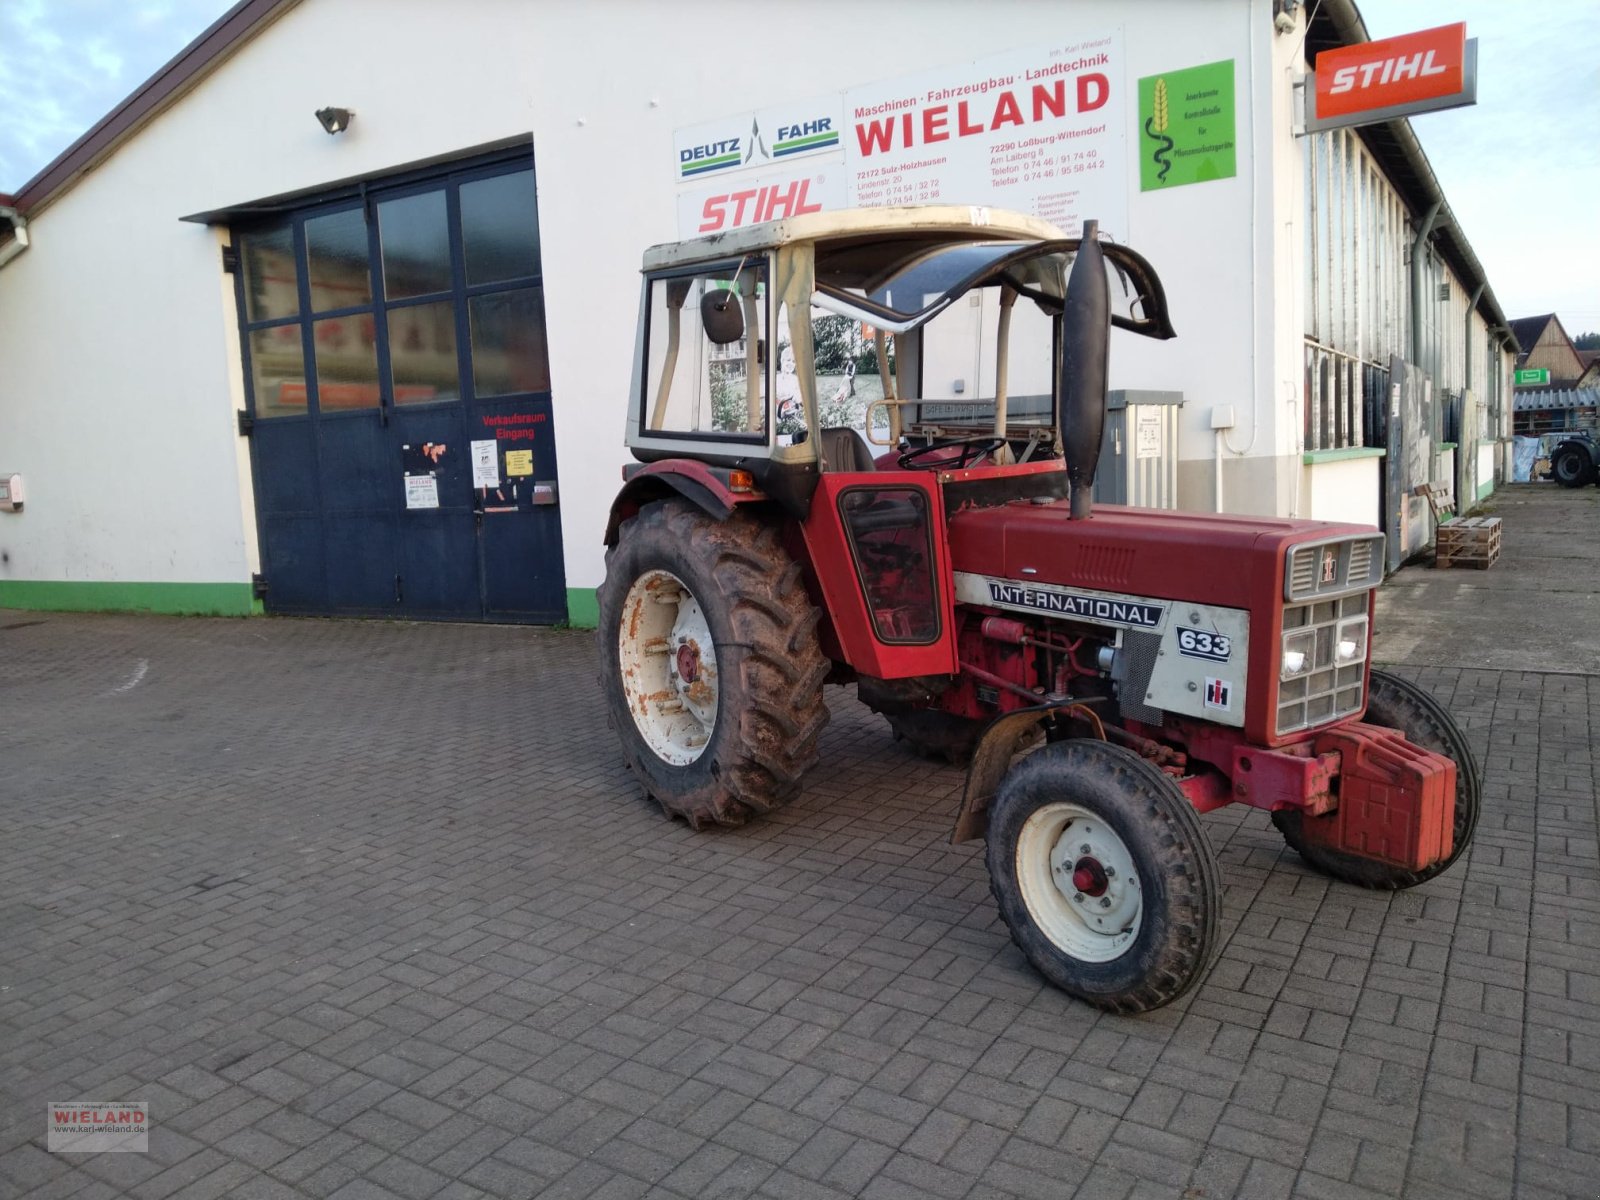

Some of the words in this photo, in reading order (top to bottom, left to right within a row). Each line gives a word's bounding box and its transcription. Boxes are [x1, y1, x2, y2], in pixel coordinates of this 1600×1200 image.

[1329, 49, 1447, 95] STIHL
[854, 97, 918, 119] Maschinen
[926, 75, 1015, 103] Fahrzeugbau
[1025, 52, 1109, 81] Landtechnik
[855, 72, 1110, 157] WIELAND
[777, 117, 832, 141] FAHR
[680, 137, 741, 162] DEUTZ
[990, 142, 1016, 154] 72290
[857, 169, 880, 180] 72172
[881, 156, 947, 175] Sulz-Holzhausen
[990, 156, 1004, 165] Am
[991, 164, 1020, 176] Telefon
[1023, 162, 1029, 170] 0
[1032, 159, 1041, 169] 74
[991, 176, 1019, 188] Telefax
[1023, 173, 1029, 182] 0
[1032, 171, 1041, 181] 74
[698, 178, 823, 233] STIHL
[857, 190, 883, 201] Telefon
[482, 413, 546, 427] Verkaufsraum
[496, 428, 535, 441] Eingang
[994, 584, 1156, 625] INTERNATIONAL
[1180, 629, 1231, 656] 633
